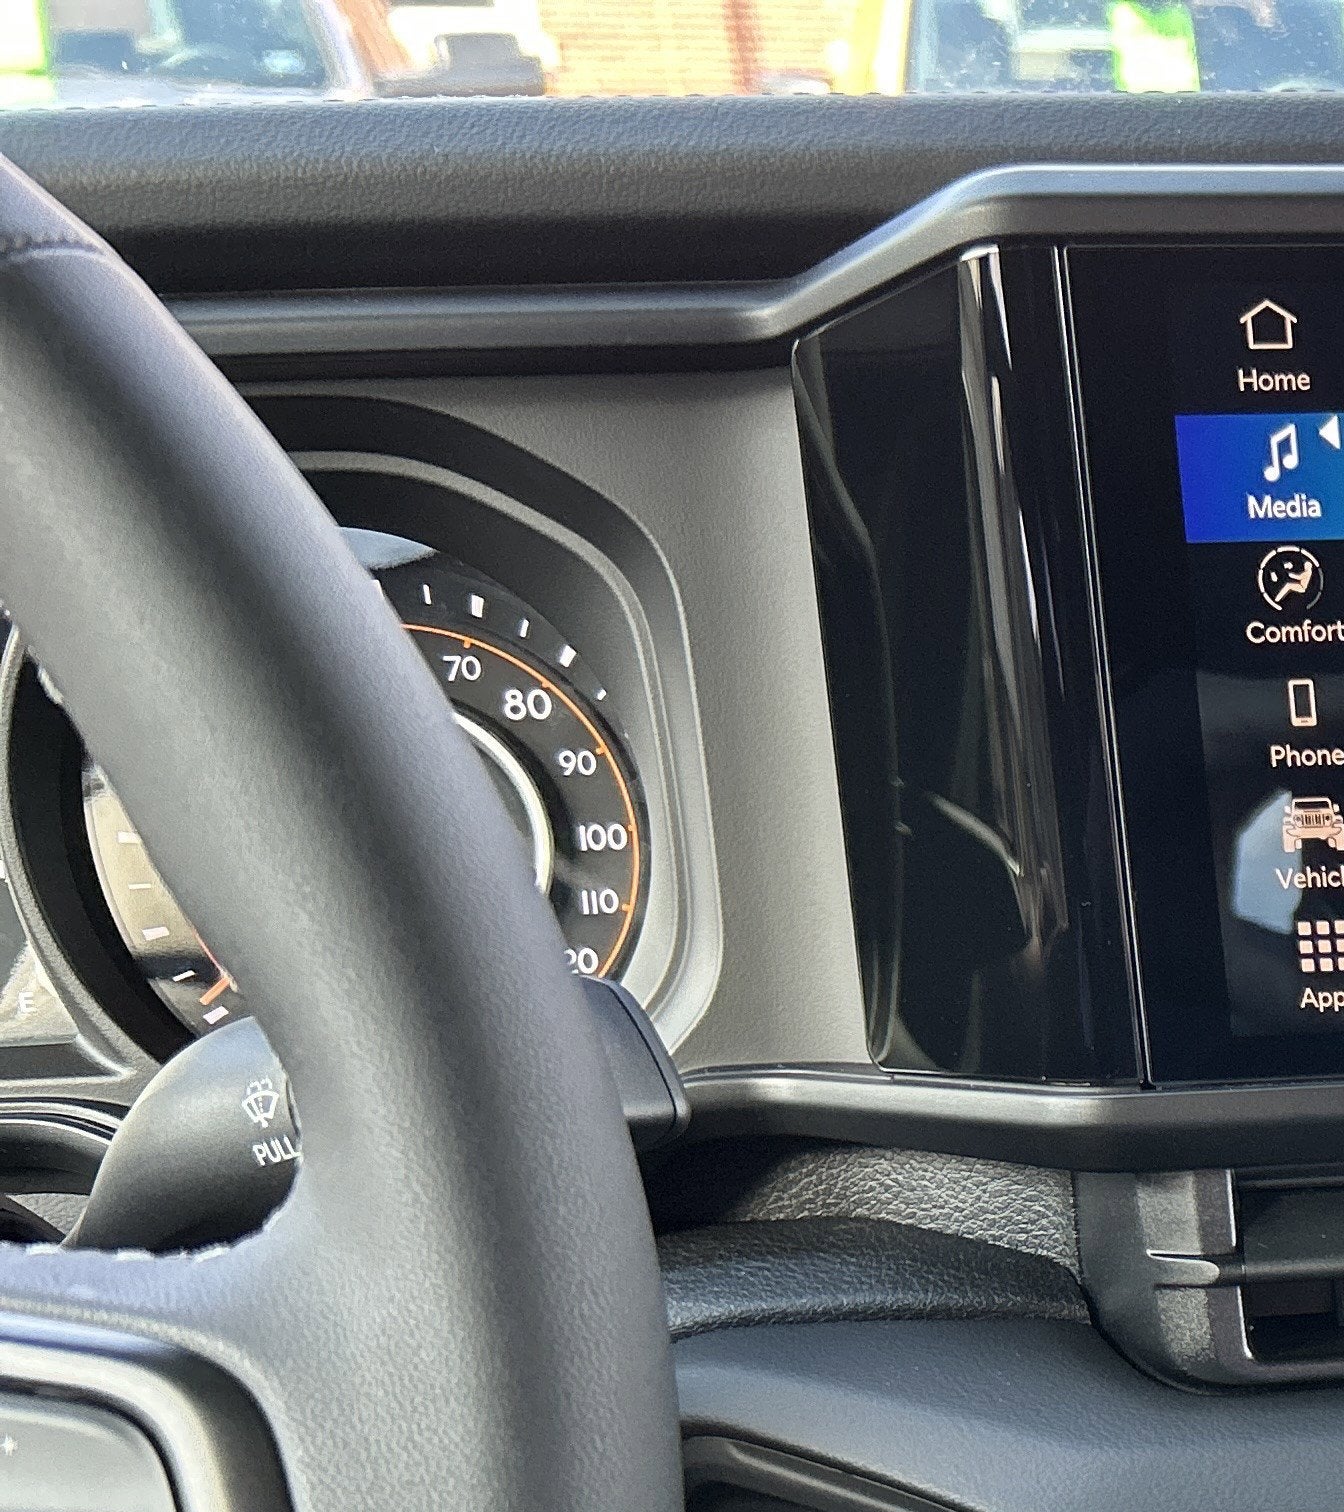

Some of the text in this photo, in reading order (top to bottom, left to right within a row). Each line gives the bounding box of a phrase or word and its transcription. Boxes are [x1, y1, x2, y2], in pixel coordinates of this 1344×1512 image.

[1237, 368, 1311, 392] Home
[1247, 495, 1322, 518] Media
[442, 654, 482, 682] 70
[504, 689, 551, 721] 80
[558, 750, 597, 777] 90
[1269, 744, 1344, 768] Phone
[578, 824, 628, 852] 100
[581, 890, 619, 915] 110
[563, 946, 599, 975] 20
[18, 991, 37, 1013] E
[253, 1137, 298, 1167] PULL
